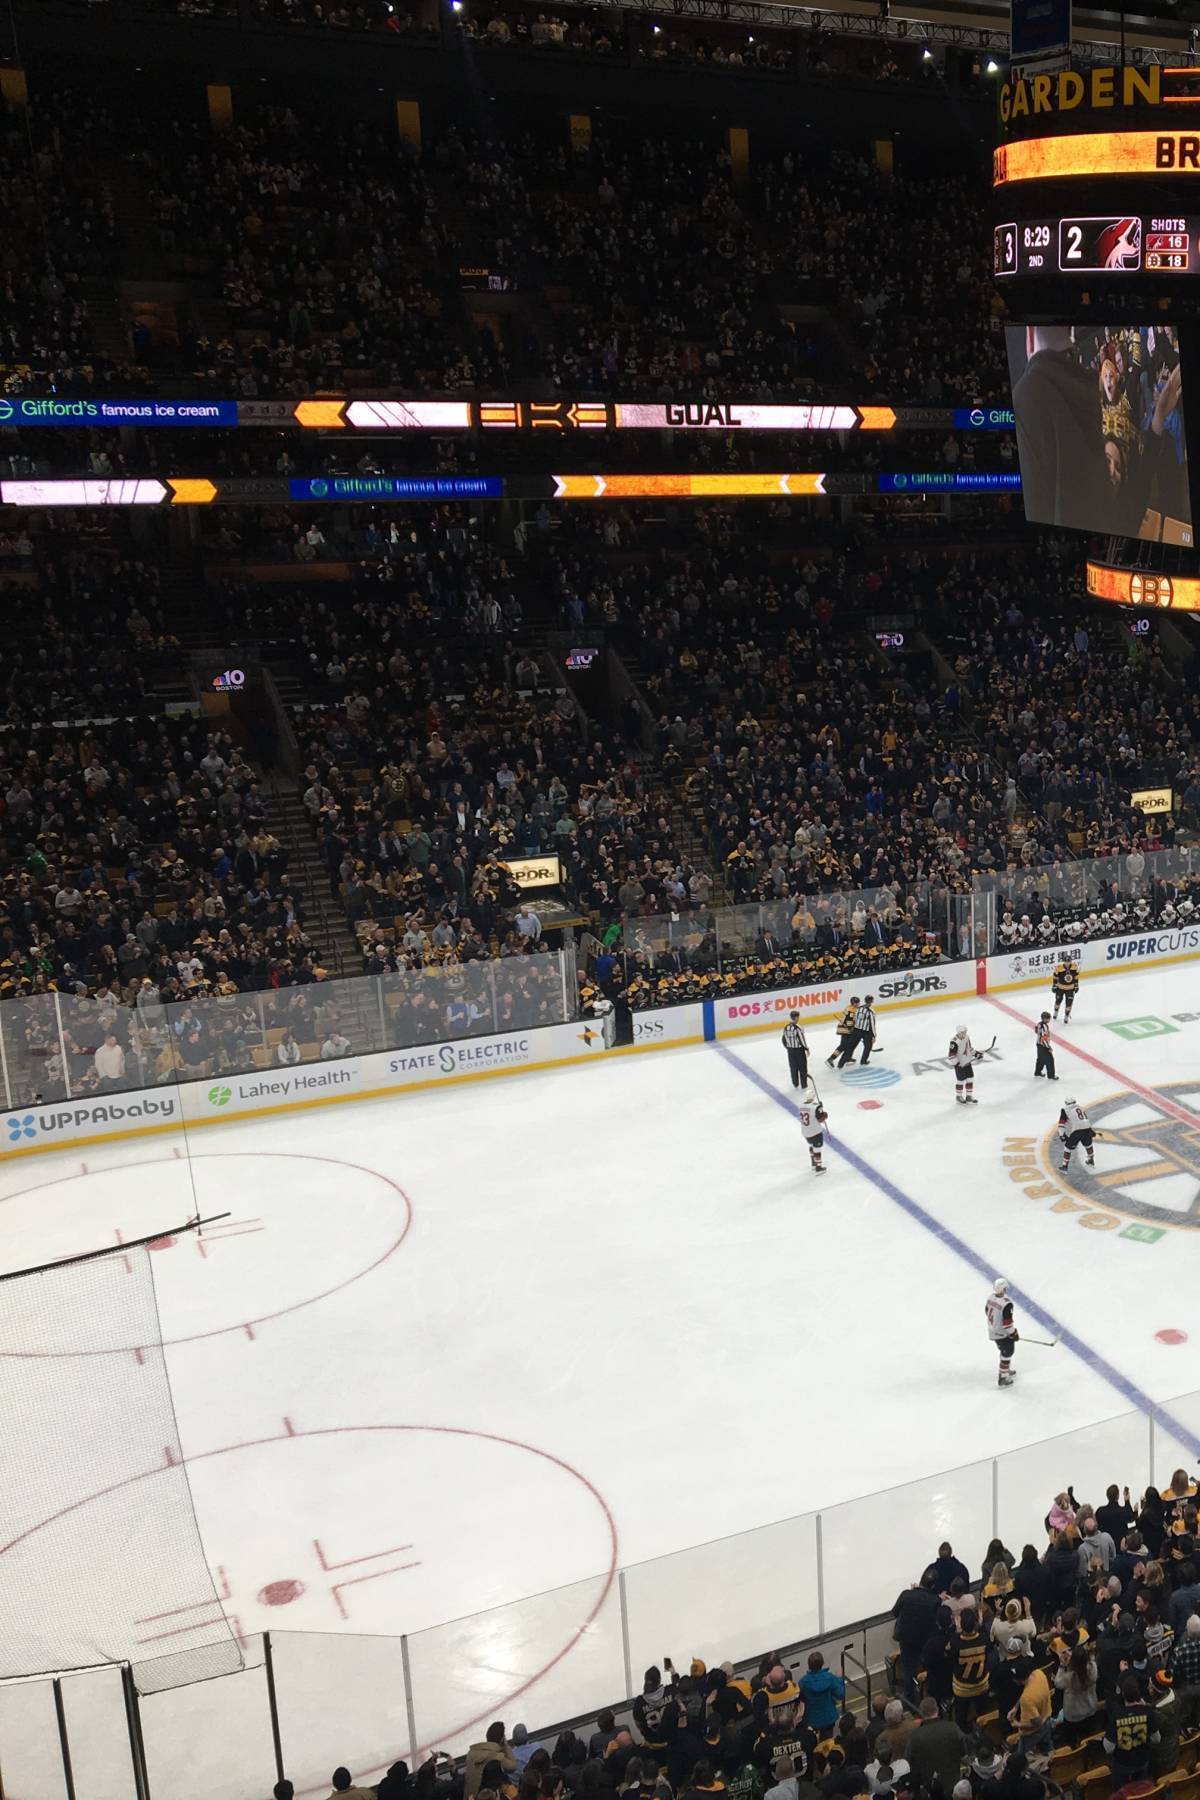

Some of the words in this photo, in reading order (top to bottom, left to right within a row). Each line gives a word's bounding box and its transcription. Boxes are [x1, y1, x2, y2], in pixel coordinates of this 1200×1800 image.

[1000, 64, 1161, 122] GARDEN
[1151, 219, 1186, 231] SHOTS
[1005, 233, 1013, 263] 3
[1024, 227, 1050, 249] 8:29
[1067, 227, 1082, 259] 2
[1169, 236, 1182, 248] 16
[1029, 255, 1043, 267] 2ND
[1168, 256, 1181, 267] 18
[21, 400, 98, 416] Gifford's
[102, 404, 152, 417] famous
[155, 404, 169, 416] ice
[171, 406, 219, 417] cream
[666, 404, 741, 426] GOAL
[1137, 619, 1149, 631] 10
[223, 669, 245, 685] 10
[1106, 930, 1200, 960] SUPERCUTS
[728, 1004, 761, 1018] BOS
[775, 989, 843, 1012] DUNKIN'
[1113, 1020, 1166, 1035] TD
[390, 1056, 436, 1073] STATE
[457, 1040, 529, 1062] ELECTRIC
[239, 1081, 290, 1101] Lahey
[295, 1070, 351, 1089] Health
[40, 1099, 175, 1132] UPPAbaby
[773, 1742, 802, 1756] DEXTER
[1117, 1724, 1148, 1752] 63
